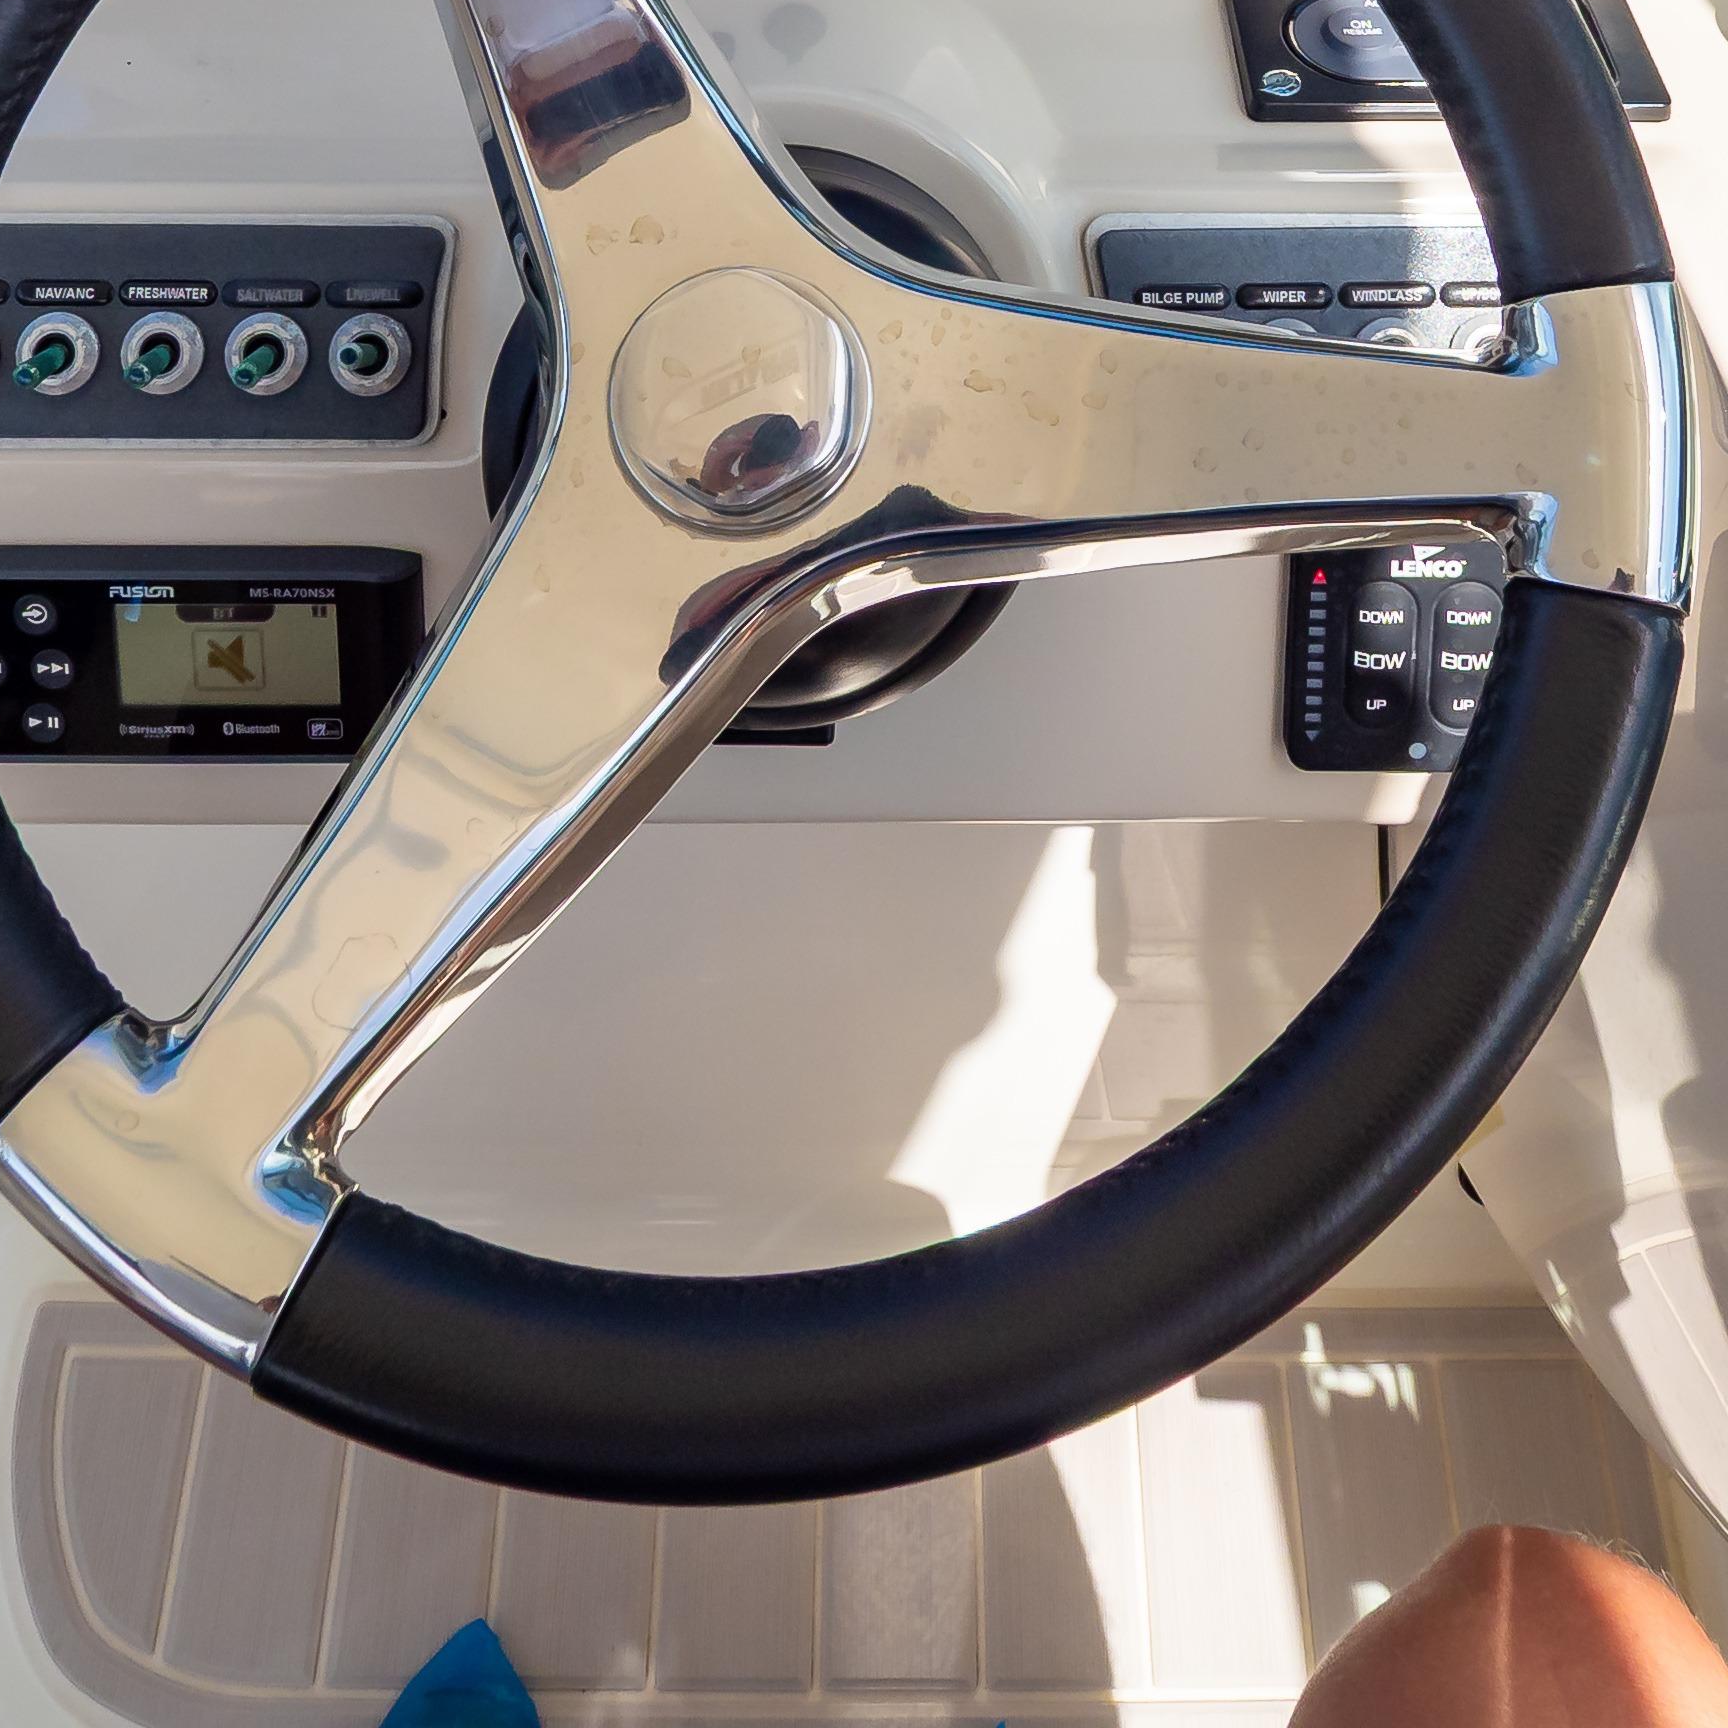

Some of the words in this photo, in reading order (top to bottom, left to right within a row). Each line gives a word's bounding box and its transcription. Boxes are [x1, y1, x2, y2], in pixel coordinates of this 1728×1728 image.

[1350, 19, 1373, 29] ON
[35, 286, 95, 300] NAV/ANC
[128, 286, 208, 301] FRESHWATER
[237, 287, 304, 303] SALTWATER
[345, 287, 401, 302] LIVEWELL
[1142, 292, 1182, 304] BILGE
[1186, 291, 1224, 304] PUMP
[1263, 290, 1307, 303] WIPER
[1352, 290, 1423, 303] WINDLASS
[1390, 559, 1463, 578] LENCO
[109, 586, 175, 598] FUSION
[1359, 609, 1404, 624] DOWN
[1446, 610, 1492, 625] DOWN
[1354, 650, 1407, 670] BOW
[1441, 650, 1494, 671] BOW
[1366, 699, 1387, 711] UP
[1452, 699, 1475, 711] UP
[235, 724, 281, 735] Bluetooth
